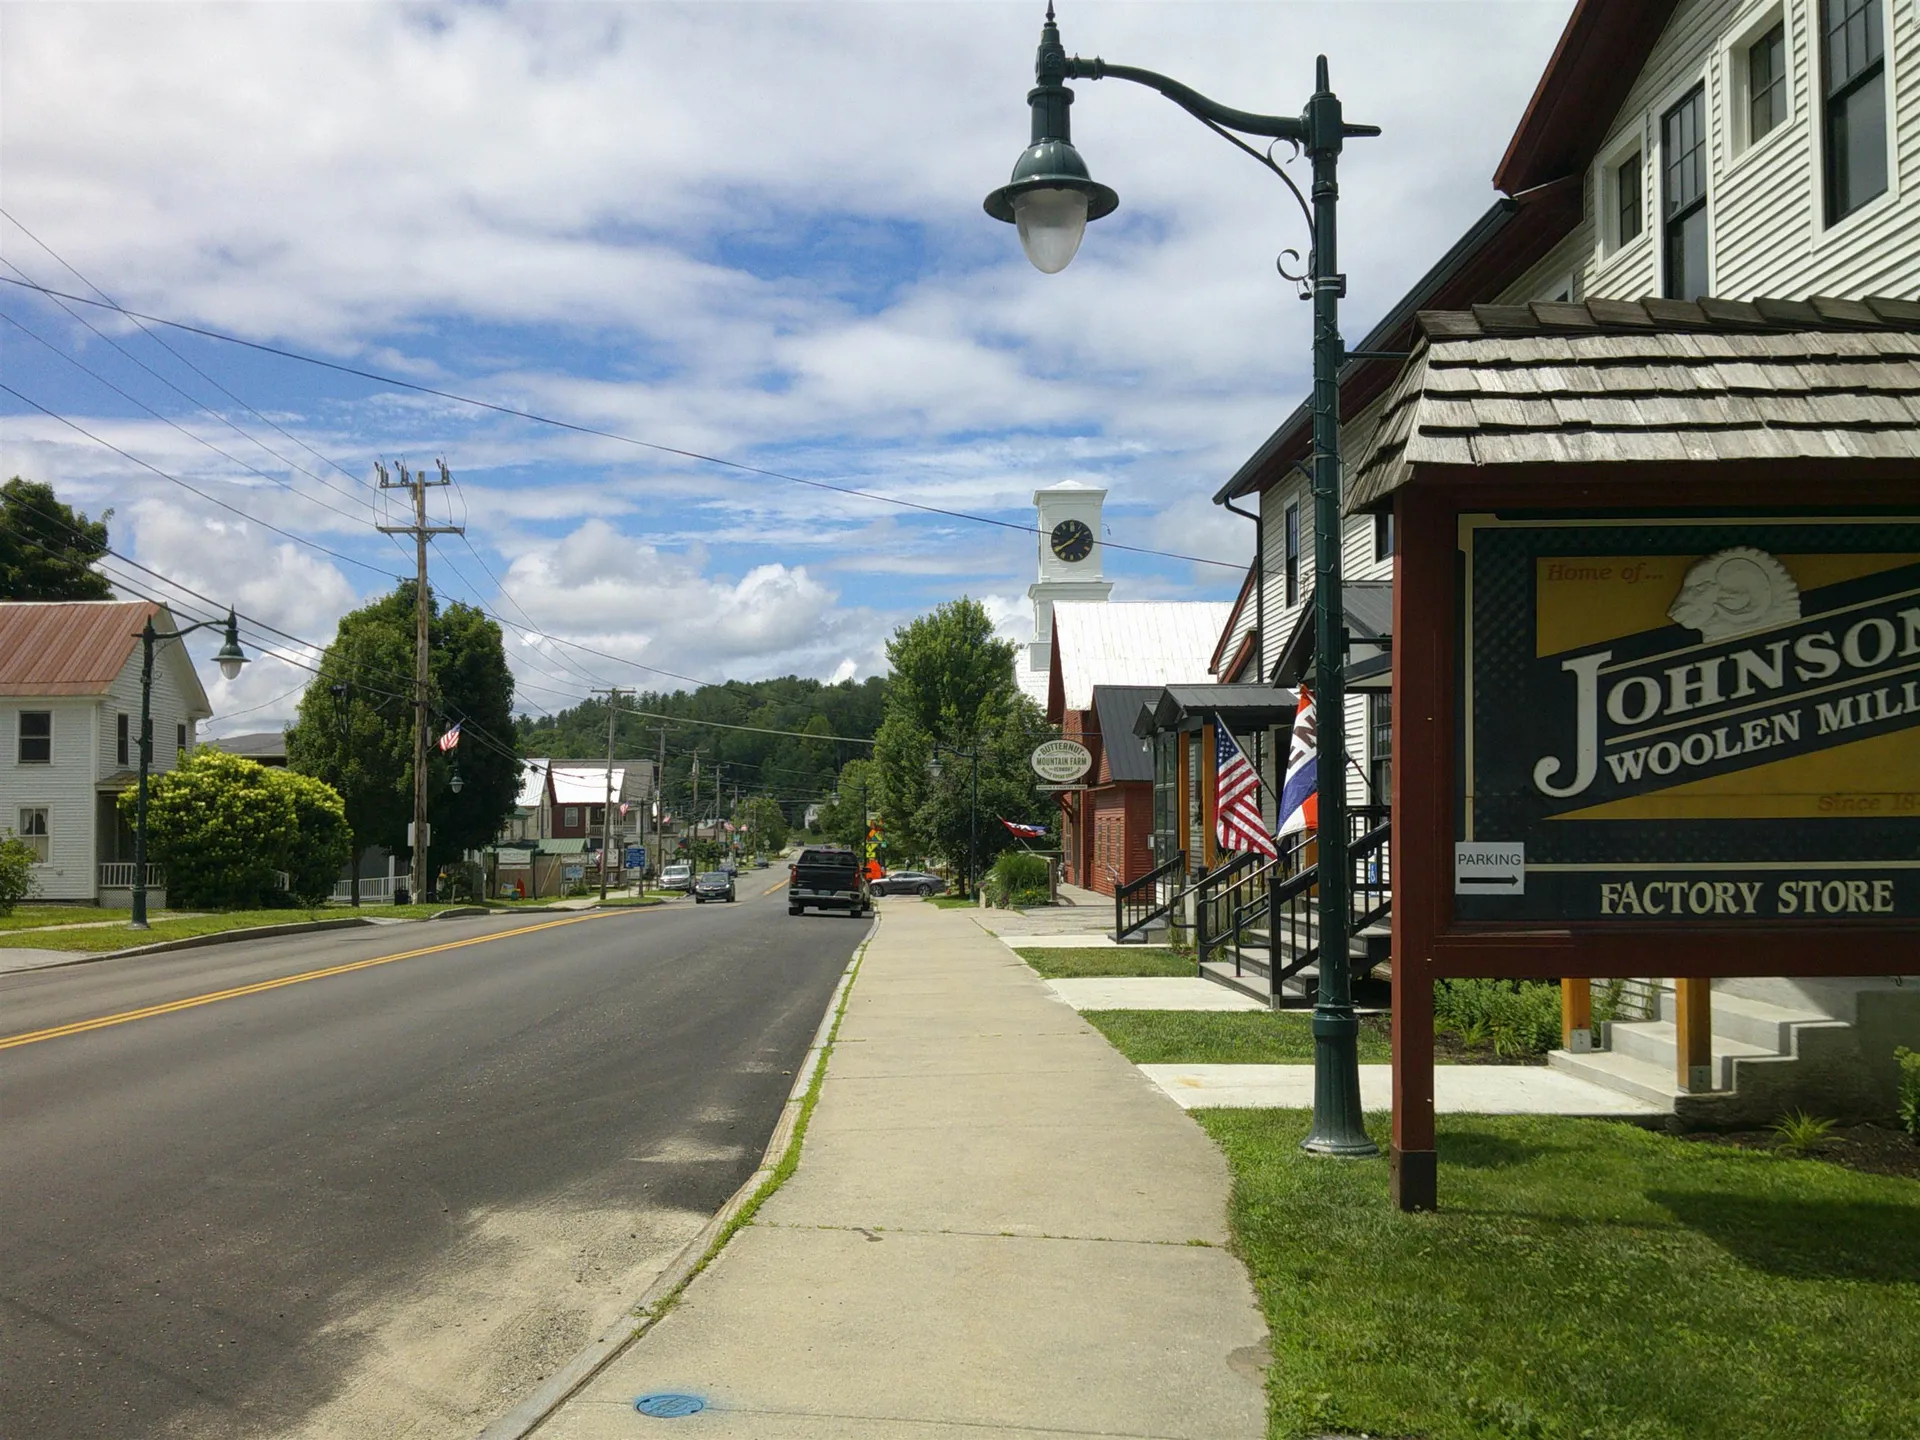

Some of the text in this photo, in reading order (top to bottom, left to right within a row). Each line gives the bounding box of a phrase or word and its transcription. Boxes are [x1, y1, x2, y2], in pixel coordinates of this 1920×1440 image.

[1546, 564, 1611, 581] Home
[1040, 742, 1084, 756] BUTTERNUT
[1604, 709, 1802, 784] WOOLEN
[1037, 757, 1087, 766] MOUNTAIN FARM
[1817, 793, 1920, 812] Since 18
[1458, 853, 1522, 866] PARKING
[1600, 880, 1895, 914] FACTORY STORE
